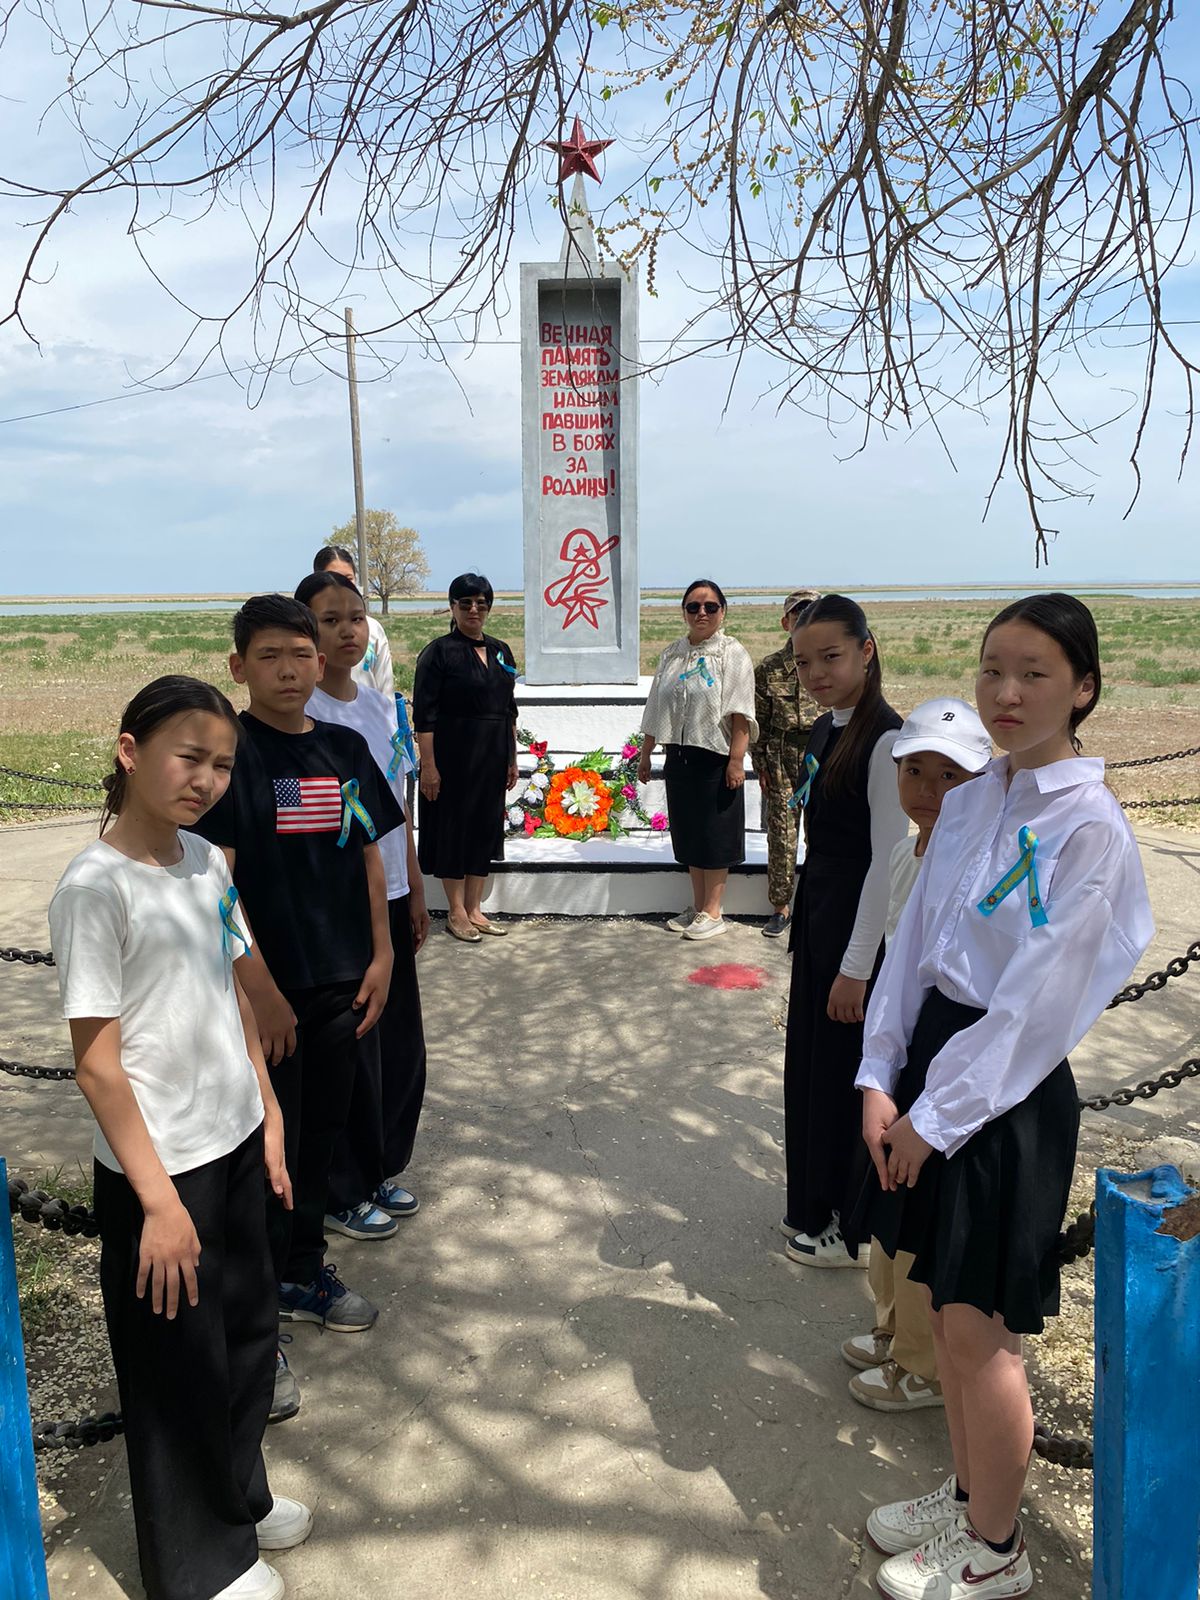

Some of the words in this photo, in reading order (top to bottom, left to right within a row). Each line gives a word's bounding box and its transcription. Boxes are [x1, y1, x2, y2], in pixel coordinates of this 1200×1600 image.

[542, 322, 612, 347] ВЕЧНАЯ
[542, 345, 611, 366] ПАМЯТЬ
[541, 369, 619, 387] ЗЕМЛЯКАМ
[553, 391, 619, 408] НАШИМ
[542, 412, 613, 430] ПАВШИМ
[553, 433, 567, 452] В
[574, 433, 615, 452] БОЯХ
[566, 456, 588, 474] ЗА
[542, 469, 615, 497] РОДИНУ!
[941, 711, 956, 722] B
